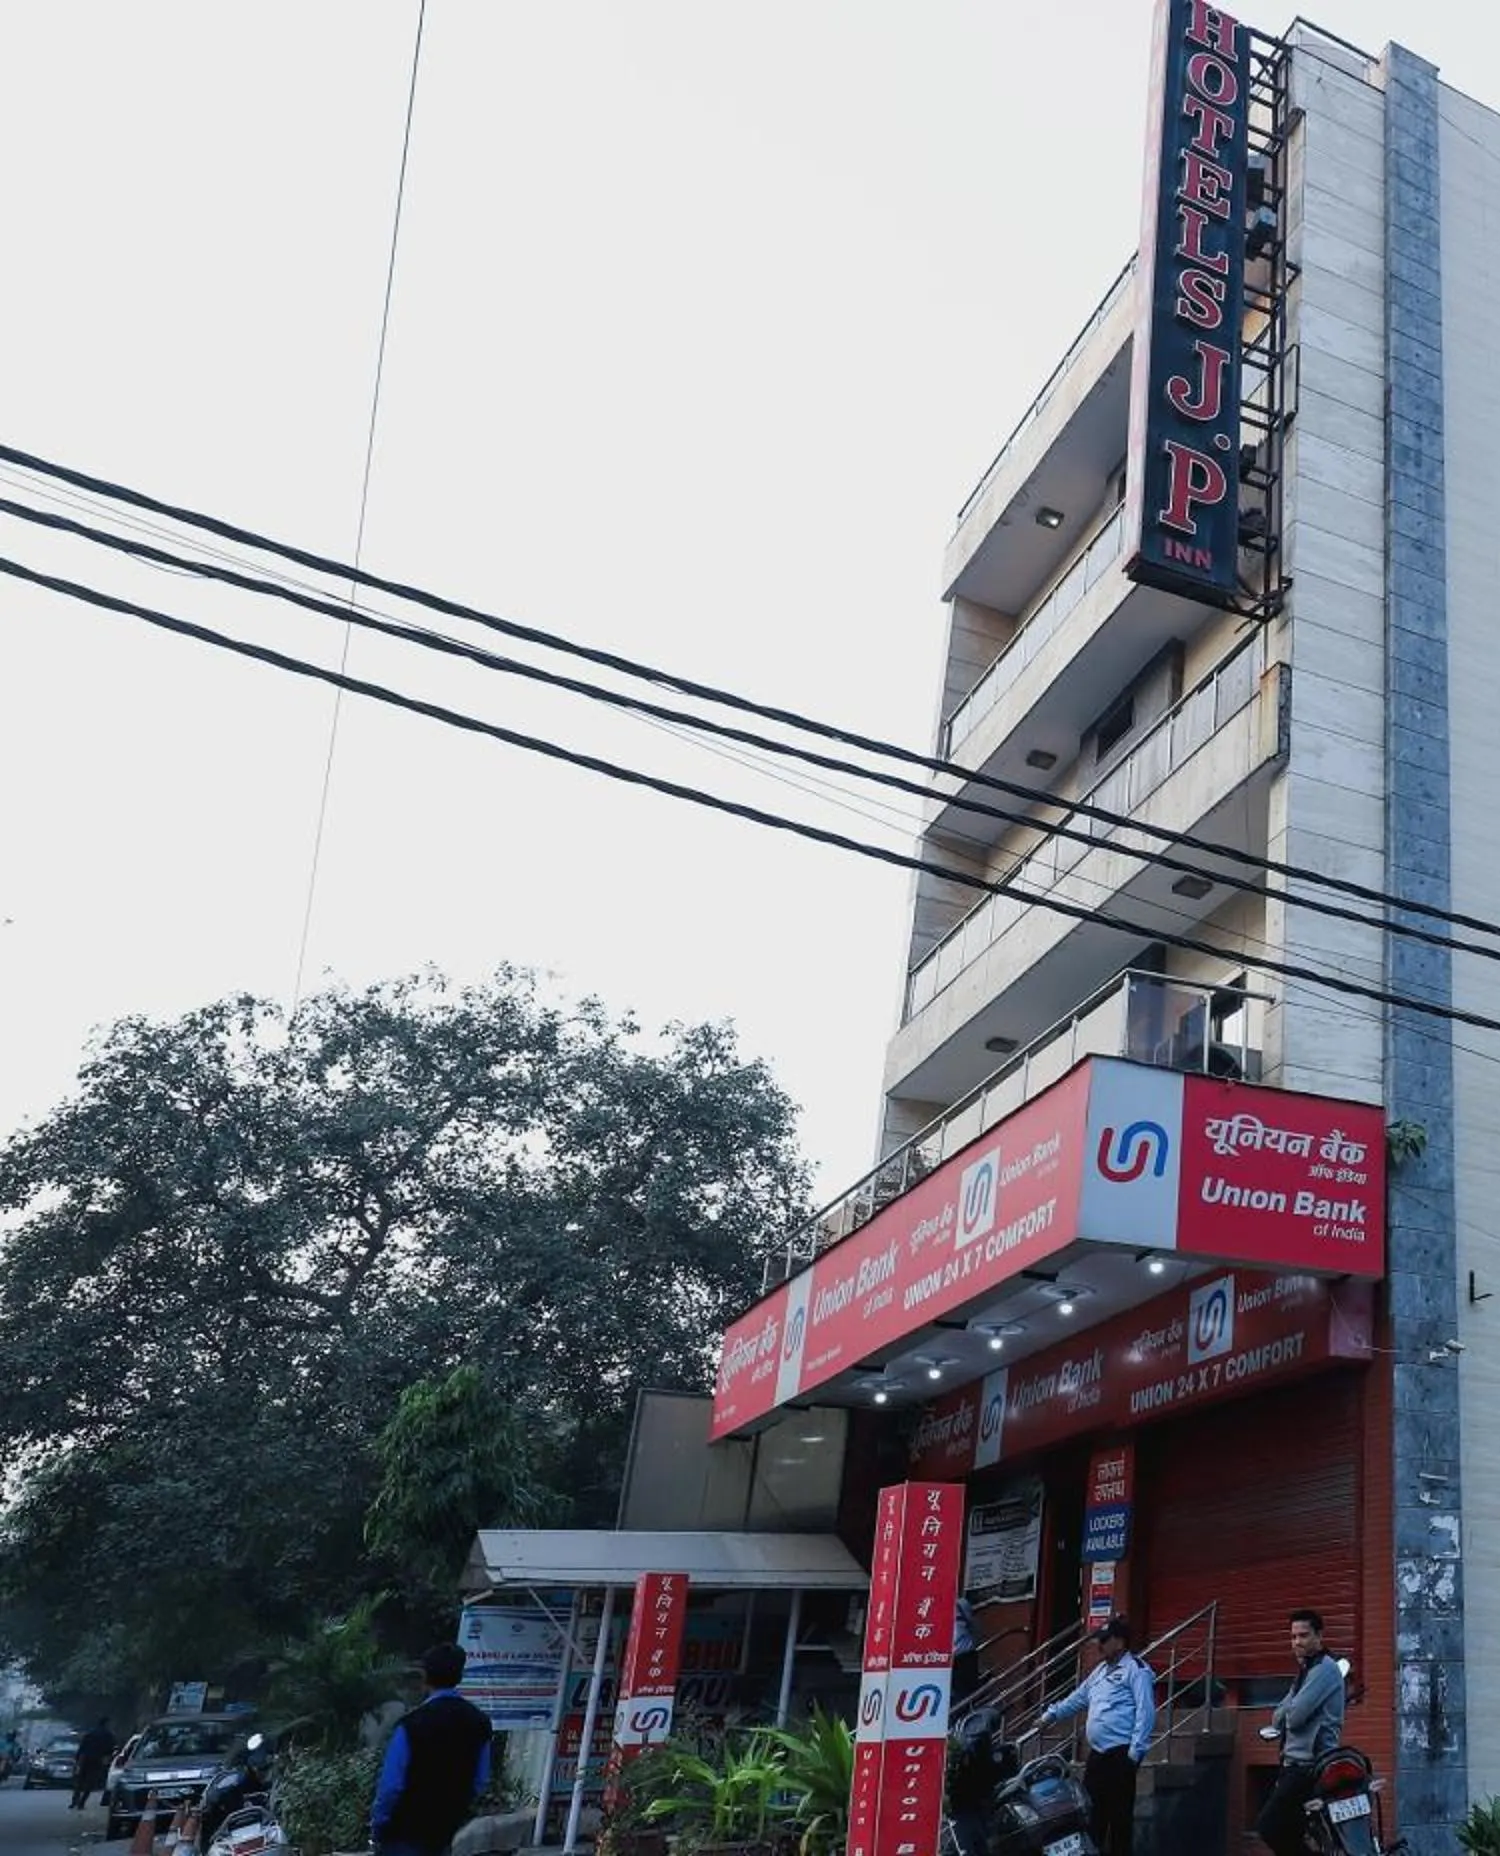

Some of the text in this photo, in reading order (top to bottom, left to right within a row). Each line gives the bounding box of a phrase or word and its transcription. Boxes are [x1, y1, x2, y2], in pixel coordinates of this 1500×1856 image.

[1177, 0, 1239, 328] HOTELS
[1163, 538, 1212, 569] INN
[1205, 1114, 1368, 1164] यूनियन बैंक
[1200, 1176, 1367, 1224] Union Bank
[904, 1270, 942, 1311] UNION
[943, 1258, 959, 1286] 24
[961, 1252, 973, 1278] X
[984, 1198, 1057, 1263] COMFORT
[1332, 1224, 1365, 1241] India
[813, 1239, 899, 1326] Union Bank
[1057, 1348, 1105, 1393] Bank
[1130, 1332, 1305, 1413] UNION 24 X 7 COMFORT
[921, 1490, 944, 1581] यूनियन
[1085, 1532, 1126, 1552] AVAILABLE
[1088, 1512, 1125, 1533] LOCKERS
[900, 1745, 925, 1822] Union
